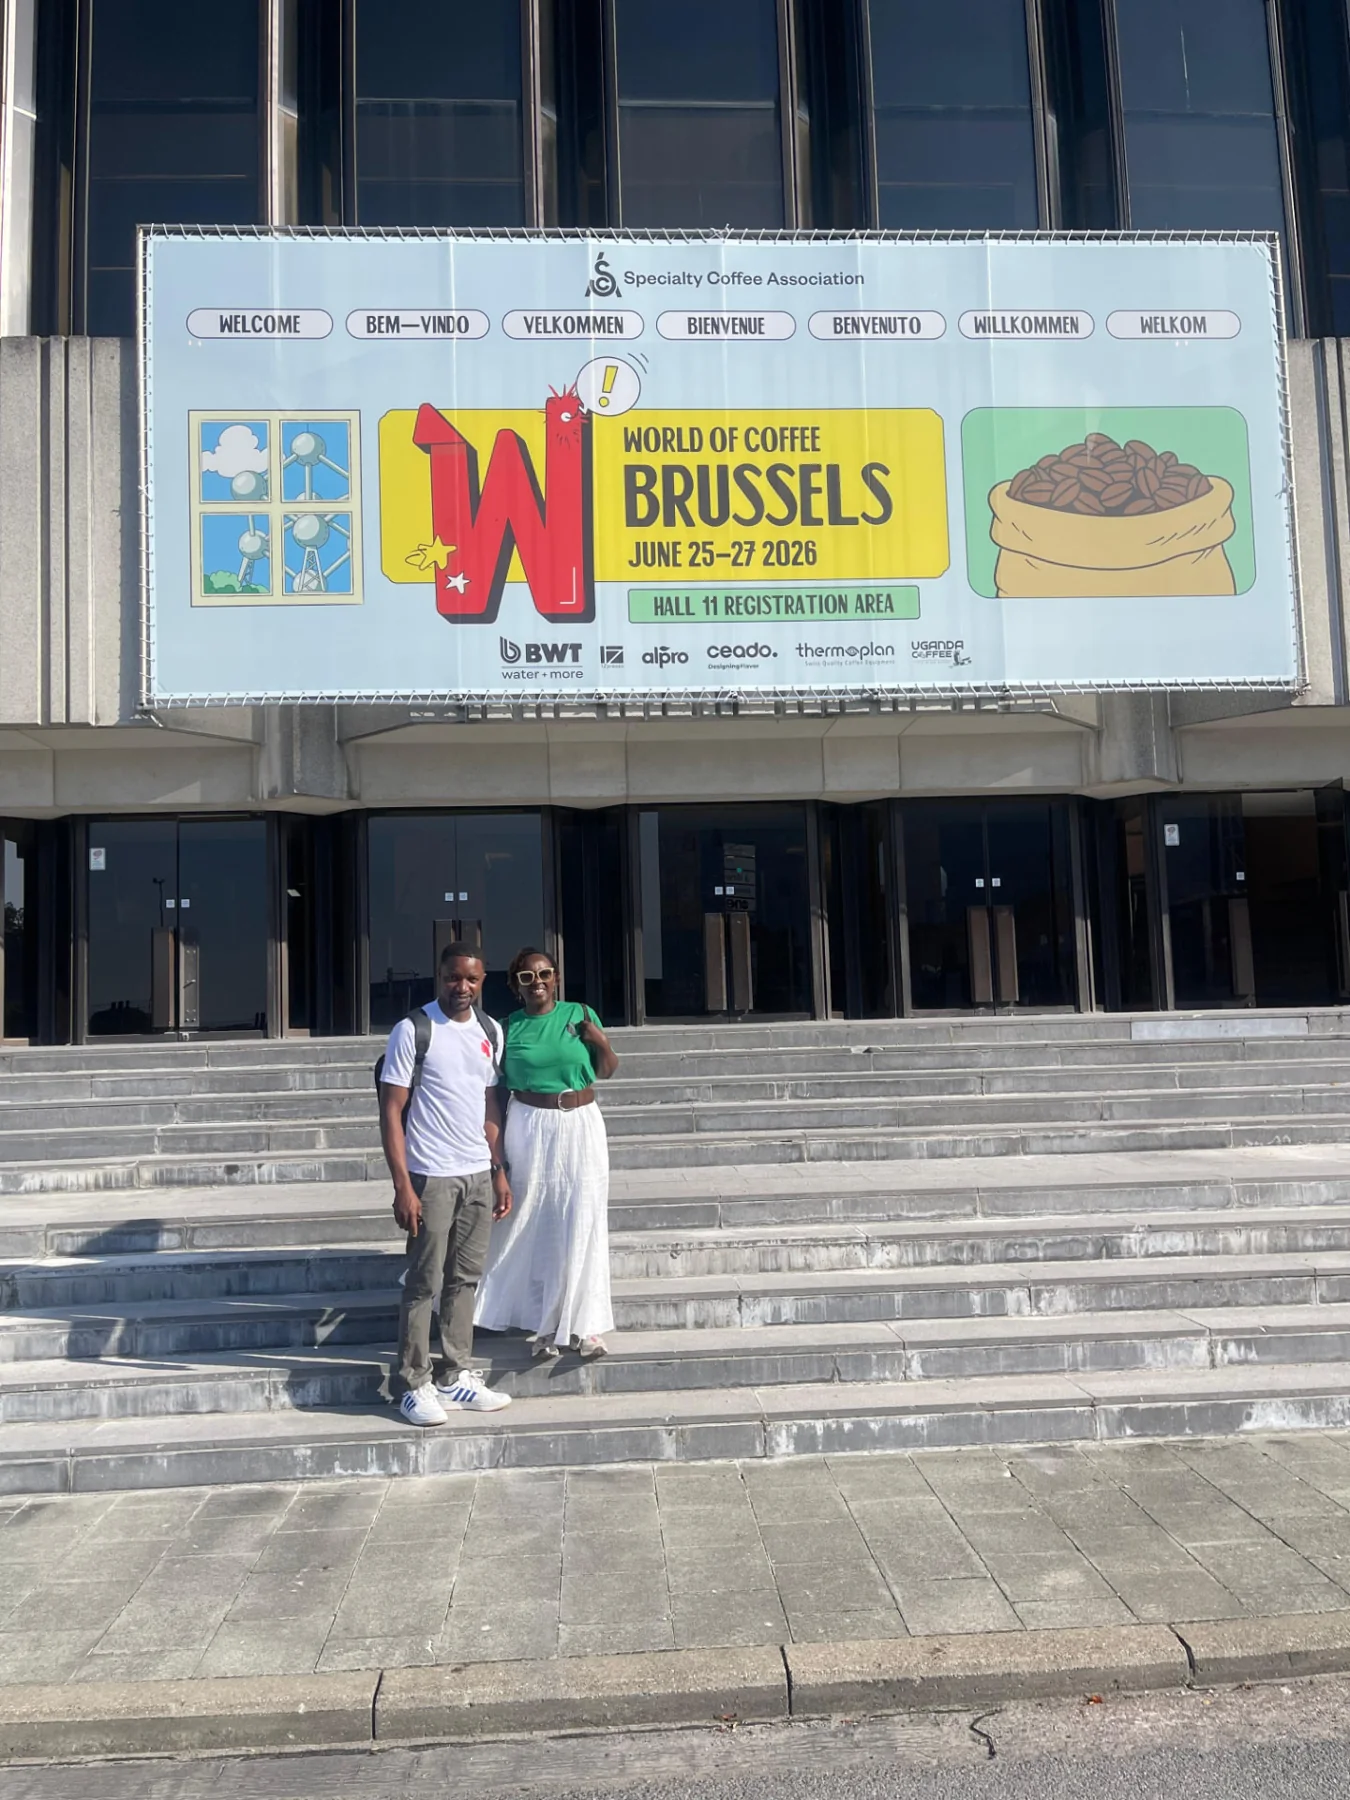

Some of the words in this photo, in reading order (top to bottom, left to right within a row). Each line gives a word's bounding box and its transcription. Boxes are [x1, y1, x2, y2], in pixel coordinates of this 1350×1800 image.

[624, 270, 703, 288] Specialty
[706, 270, 763, 286] Coffee
[766, 272, 865, 286] Association
[218, 313, 301, 335] WELCOME
[522, 314, 625, 335] VELKOMMEN
[686, 315, 766, 336] BIENVENUE
[832, 315, 922, 336] BENVENUTO
[973, 315, 1079, 335] WILLKOMMEN
[1139, 315, 1208, 334] WELKOM
[623, 426, 703, 453] WORLD
[709, 426, 739, 453] OF
[744, 426, 820, 453] COFFEE
[623, 461, 893, 527] BRUSSELS
[628, 541, 682, 567] JUNE
[762, 540, 817, 566] 2026
[653, 596, 695, 616] HALL
[702, 595, 718, 615] 11
[724, 593, 848, 615] REGISTRATION
[854, 593, 894, 613] AREA
[525, 643, 582, 663] BWT
[911, 640, 964, 650] UGANDA
[641, 646, 689, 669] alpro
[502, 670, 539, 679] water
[550, 669, 584, 679] more
